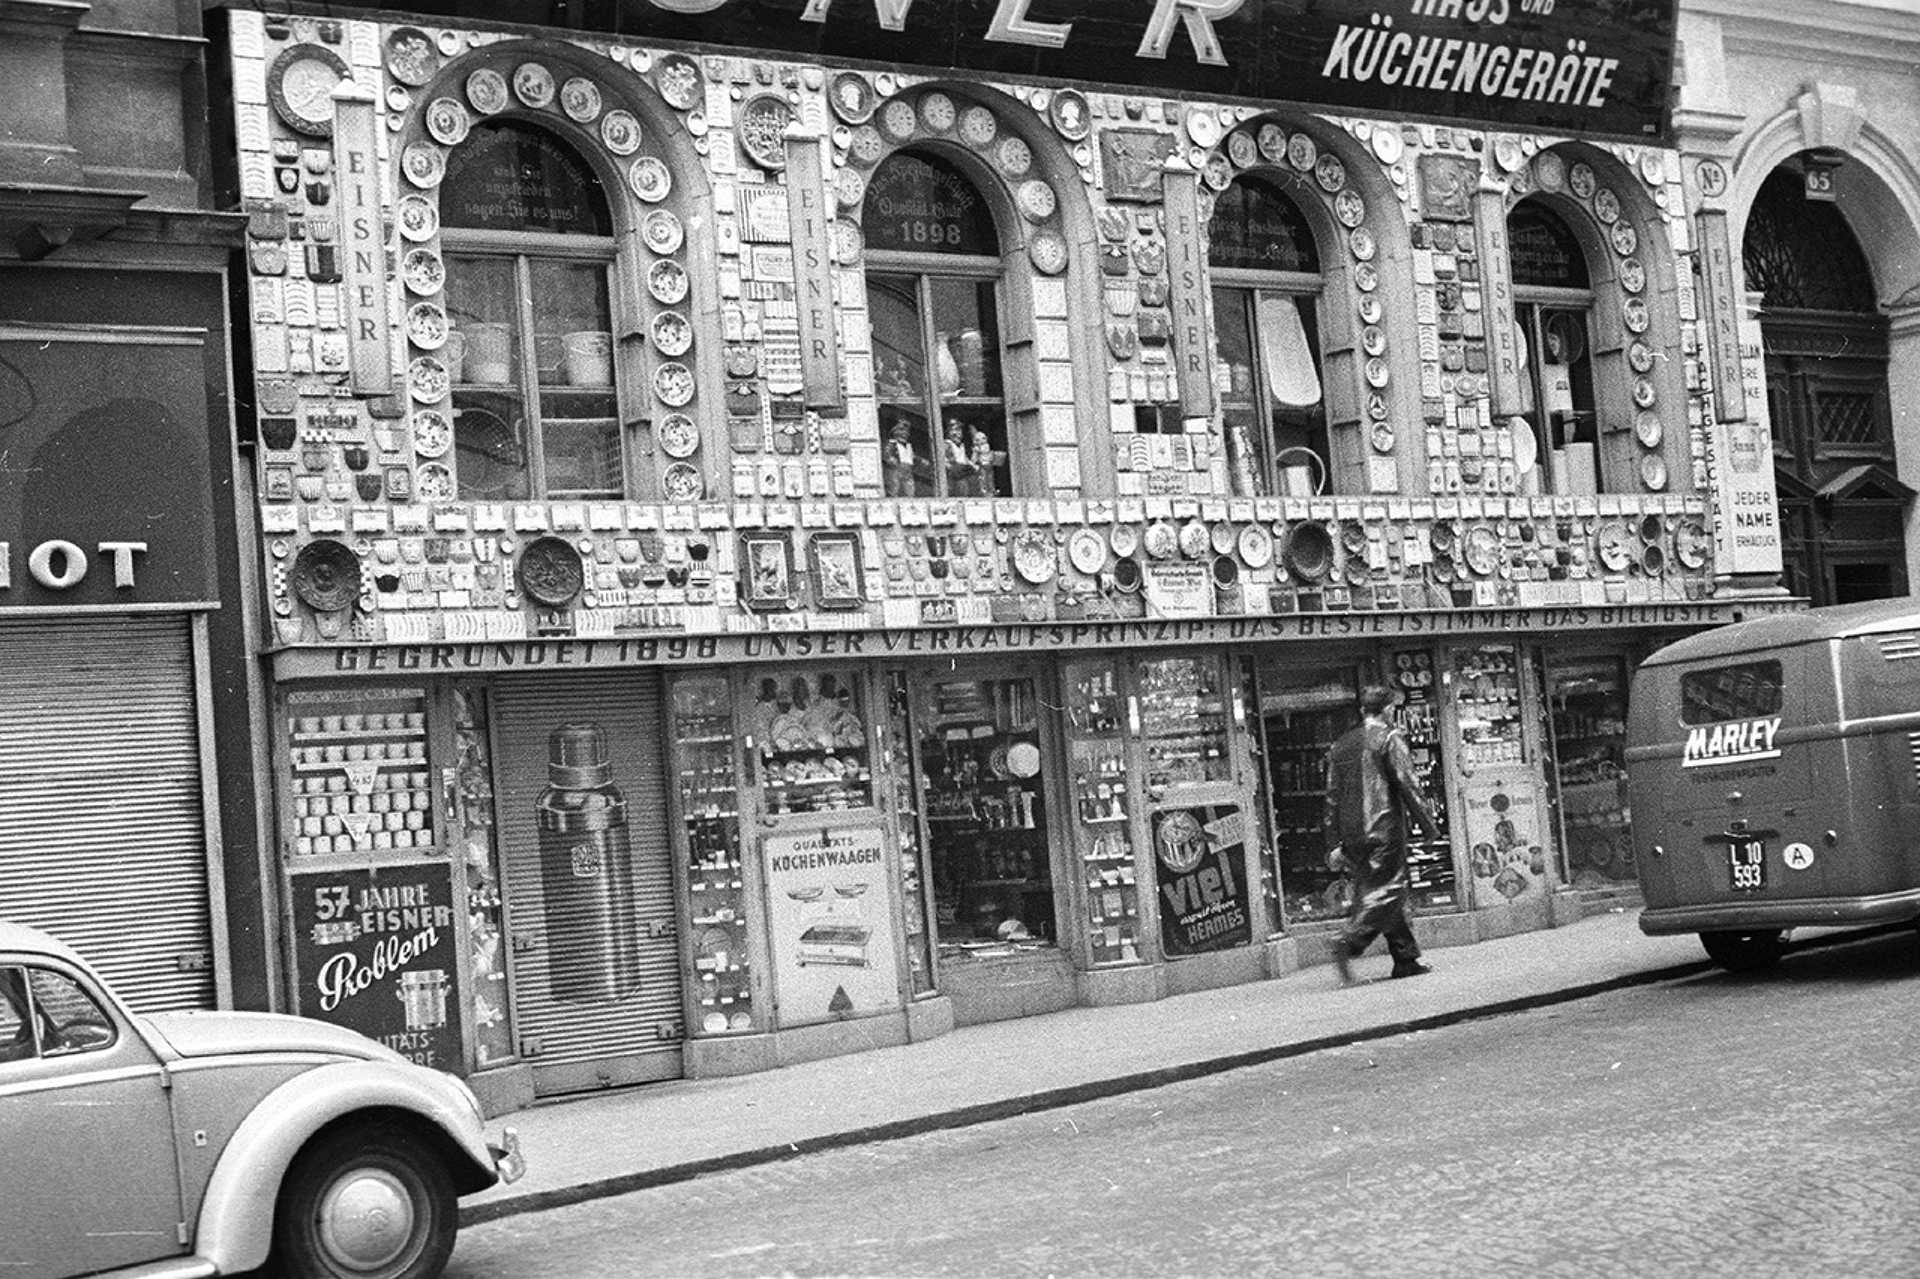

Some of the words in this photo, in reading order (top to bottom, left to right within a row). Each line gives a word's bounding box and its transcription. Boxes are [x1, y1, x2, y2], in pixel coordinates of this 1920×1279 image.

[1322, 12, 1619, 107] KÜCHENGERÄTE
[1807, 171, 1830, 191] 65
[348, 151, 378, 341] EISNER
[901, 220, 961, 245] 1898
[801, 188, 827, 359] EISNER
[1178, 215, 1201, 372] EISNER
[1490, 231, 1514, 374] EISNER
[1713, 248, 1736, 382] EISNER
[1733, 490, 1772, 505] JEDER
[1736, 511, 1773, 528] NAME
[616, 636, 718, 661] 1898
[744, 632, 865, 657] UNSER
[881, 620, 1215, 651] VERKAUFSPRINZIP:
[1230, 617, 1285, 638] DAS
[1299, 615, 1385, 636] BESTE
[1446, 609, 1529, 630] IMMER
[1543, 606, 1589, 627] DAS
[1600, 603, 1719, 624] BILLIGSTE
[1684, 716, 1781, 760] MARLEY
[1730, 844, 1741, 866] L
[1744, 841, 1762, 865] 10
[1791, 847, 1807, 865] A
[1733, 864, 1761, 888] 593
[314, 885, 350, 920] 57
[353, 883, 430, 912] JAHRE
[361, 905, 450, 933] EISNER
[1187, 908, 1245, 944] HERMES
[317, 926, 440, 1012] Problem
